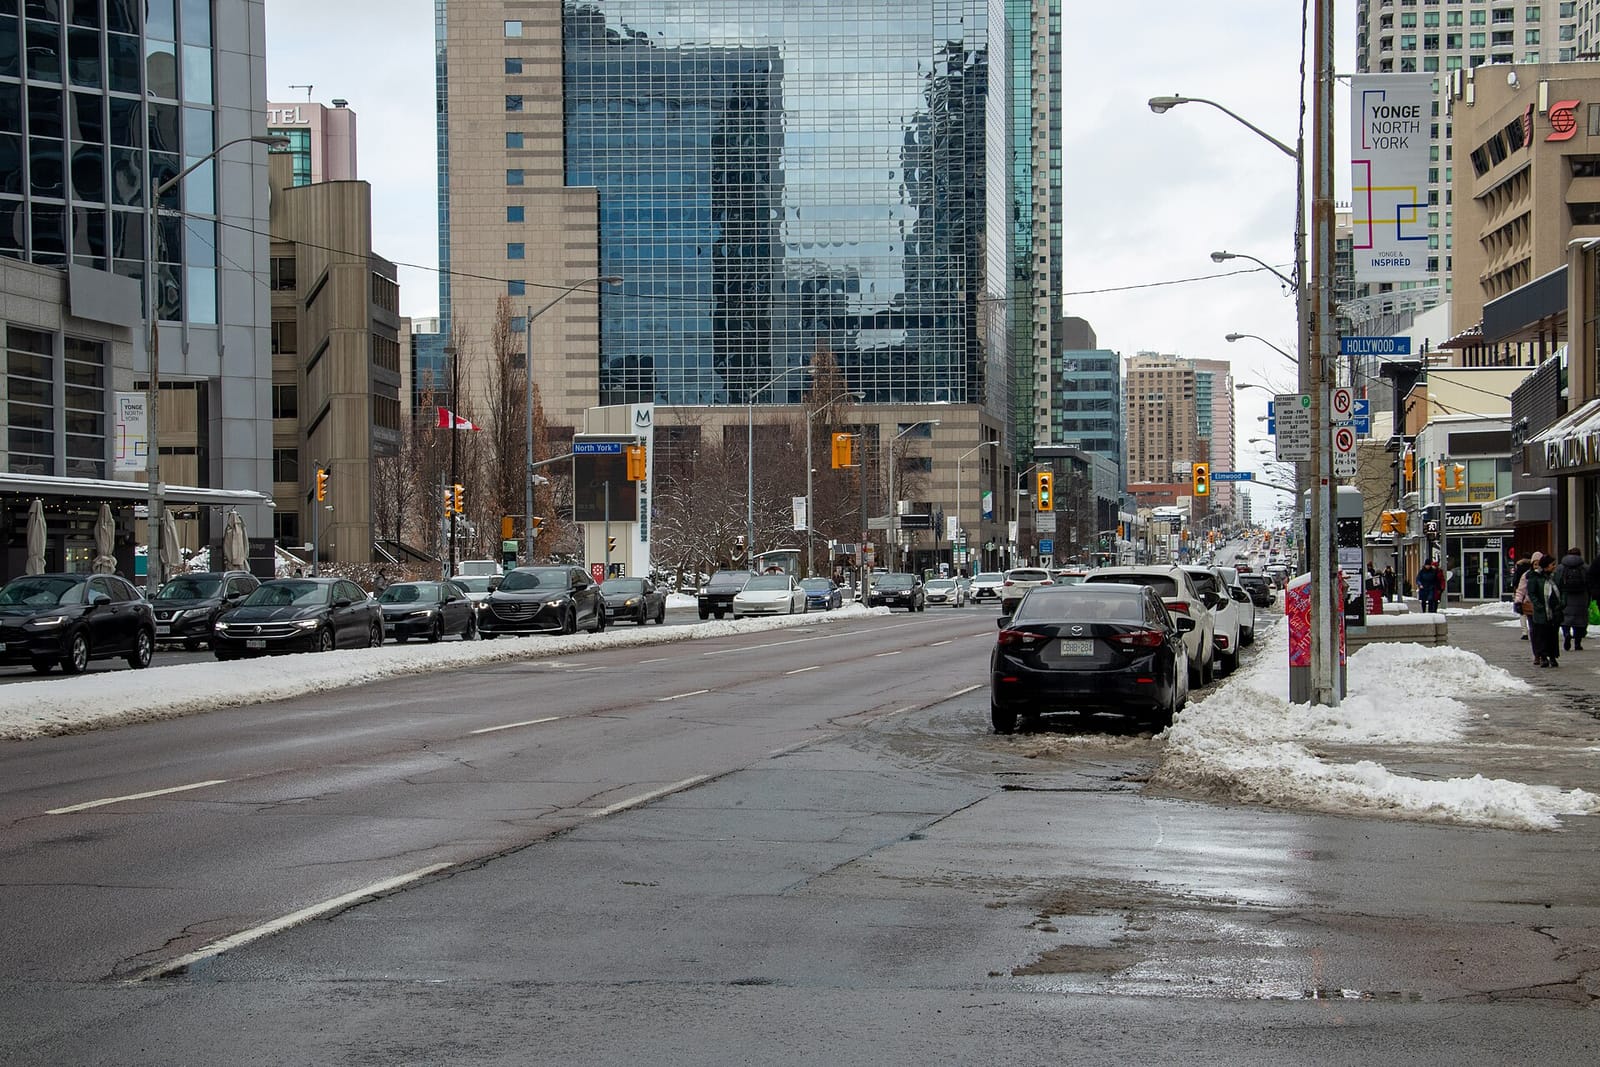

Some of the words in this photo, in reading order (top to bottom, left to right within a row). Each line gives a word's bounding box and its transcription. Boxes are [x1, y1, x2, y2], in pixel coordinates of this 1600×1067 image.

[267, 106, 309, 124] TEL
[1372, 105, 1420, 118] YONGE
[1372, 121, 1420, 134] NORTH
[1372, 137, 1409, 149] YORK
[1371, 259, 1411, 267] INSPIRED
[1347, 339, 1395, 353] HOLLYWOOD
[575, 444, 594, 452] North
[597, 444, 612, 452] York
